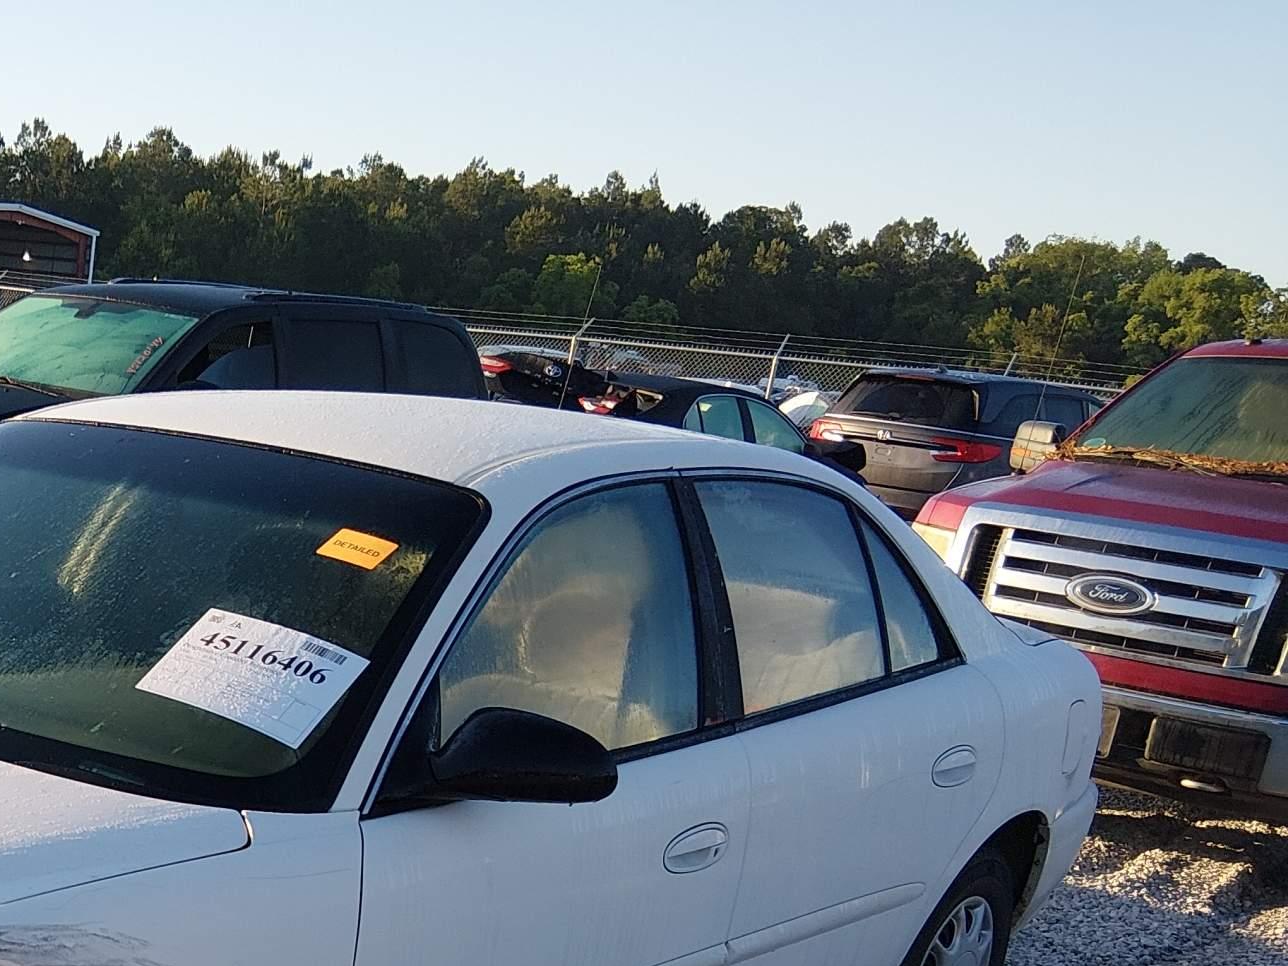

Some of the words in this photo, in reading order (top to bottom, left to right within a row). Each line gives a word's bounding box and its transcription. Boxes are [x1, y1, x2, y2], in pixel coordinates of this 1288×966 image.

[332, 539, 381, 558] DETAILED
[1088, 583, 1129, 603] Ford
[199, 632, 333, 685] 45116406
